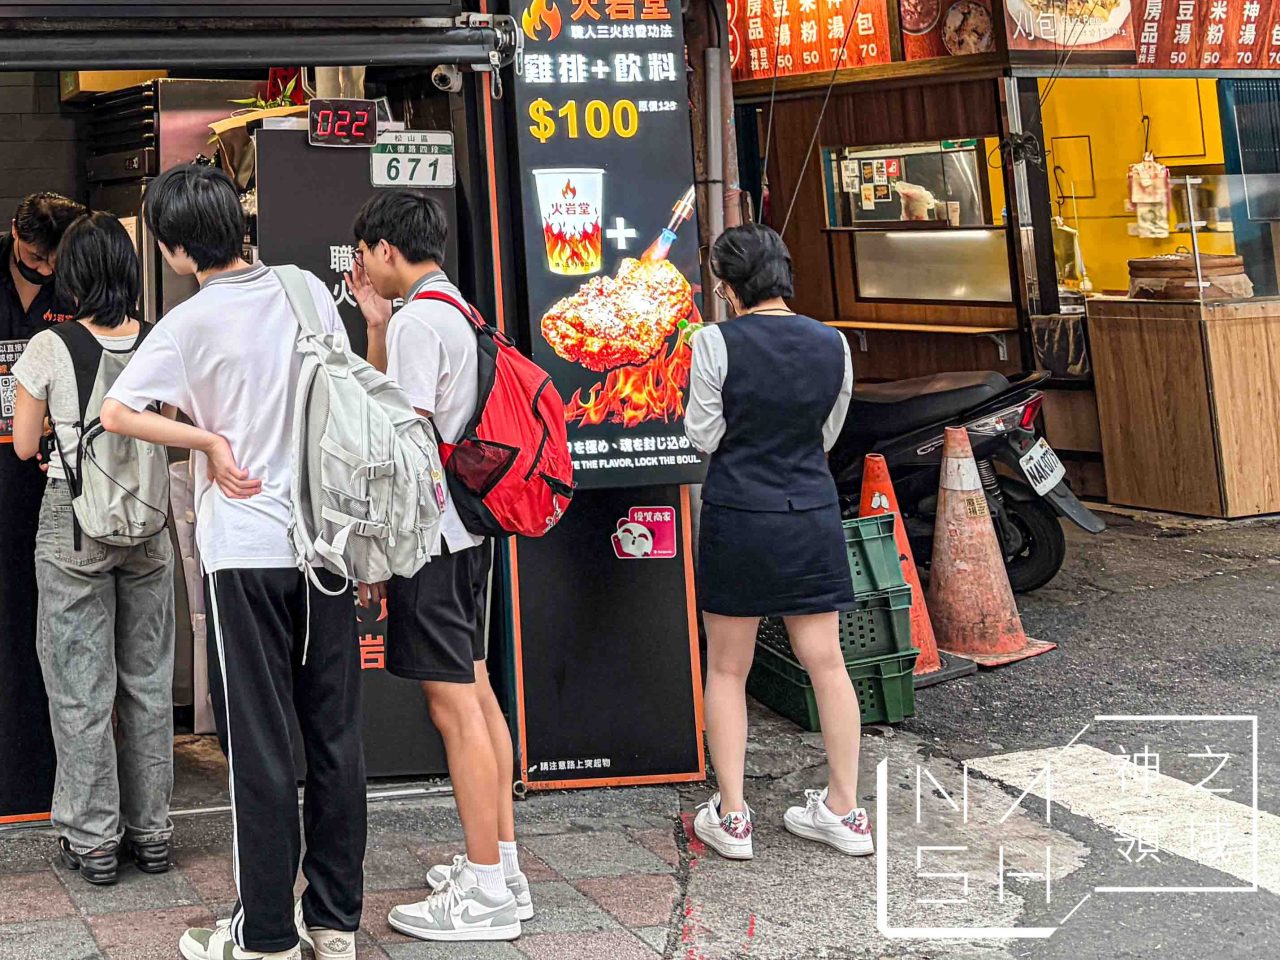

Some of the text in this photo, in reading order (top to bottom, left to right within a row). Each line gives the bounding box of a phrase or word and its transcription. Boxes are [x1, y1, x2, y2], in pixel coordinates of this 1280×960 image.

[570, 24, 673, 39] 職人三火封香功法
[802, 50, 820, 65] 50
[830, 47, 848, 61] 70
[859, 43, 878, 58] 70
[1169, 51, 1187, 64] 50
[1203, 51, 1220, 64] 50
[1236, 51, 1253, 64] 70
[777, 54, 793, 67] 50
[317, 110, 369, 137] 022
[528, 97, 639, 143] $100
[394, 134, 429, 142] 松山區
[385, 144, 439, 154] 八德路四段
[386, 157, 439, 181] 671
[552, 202, 590, 216] 火岩堂
[582, 460, 598, 469] THE
[599, 458, 634, 469] FLAVOR,
[635, 456, 658, 467] LOCK
[659, 455, 675, 465] THE
